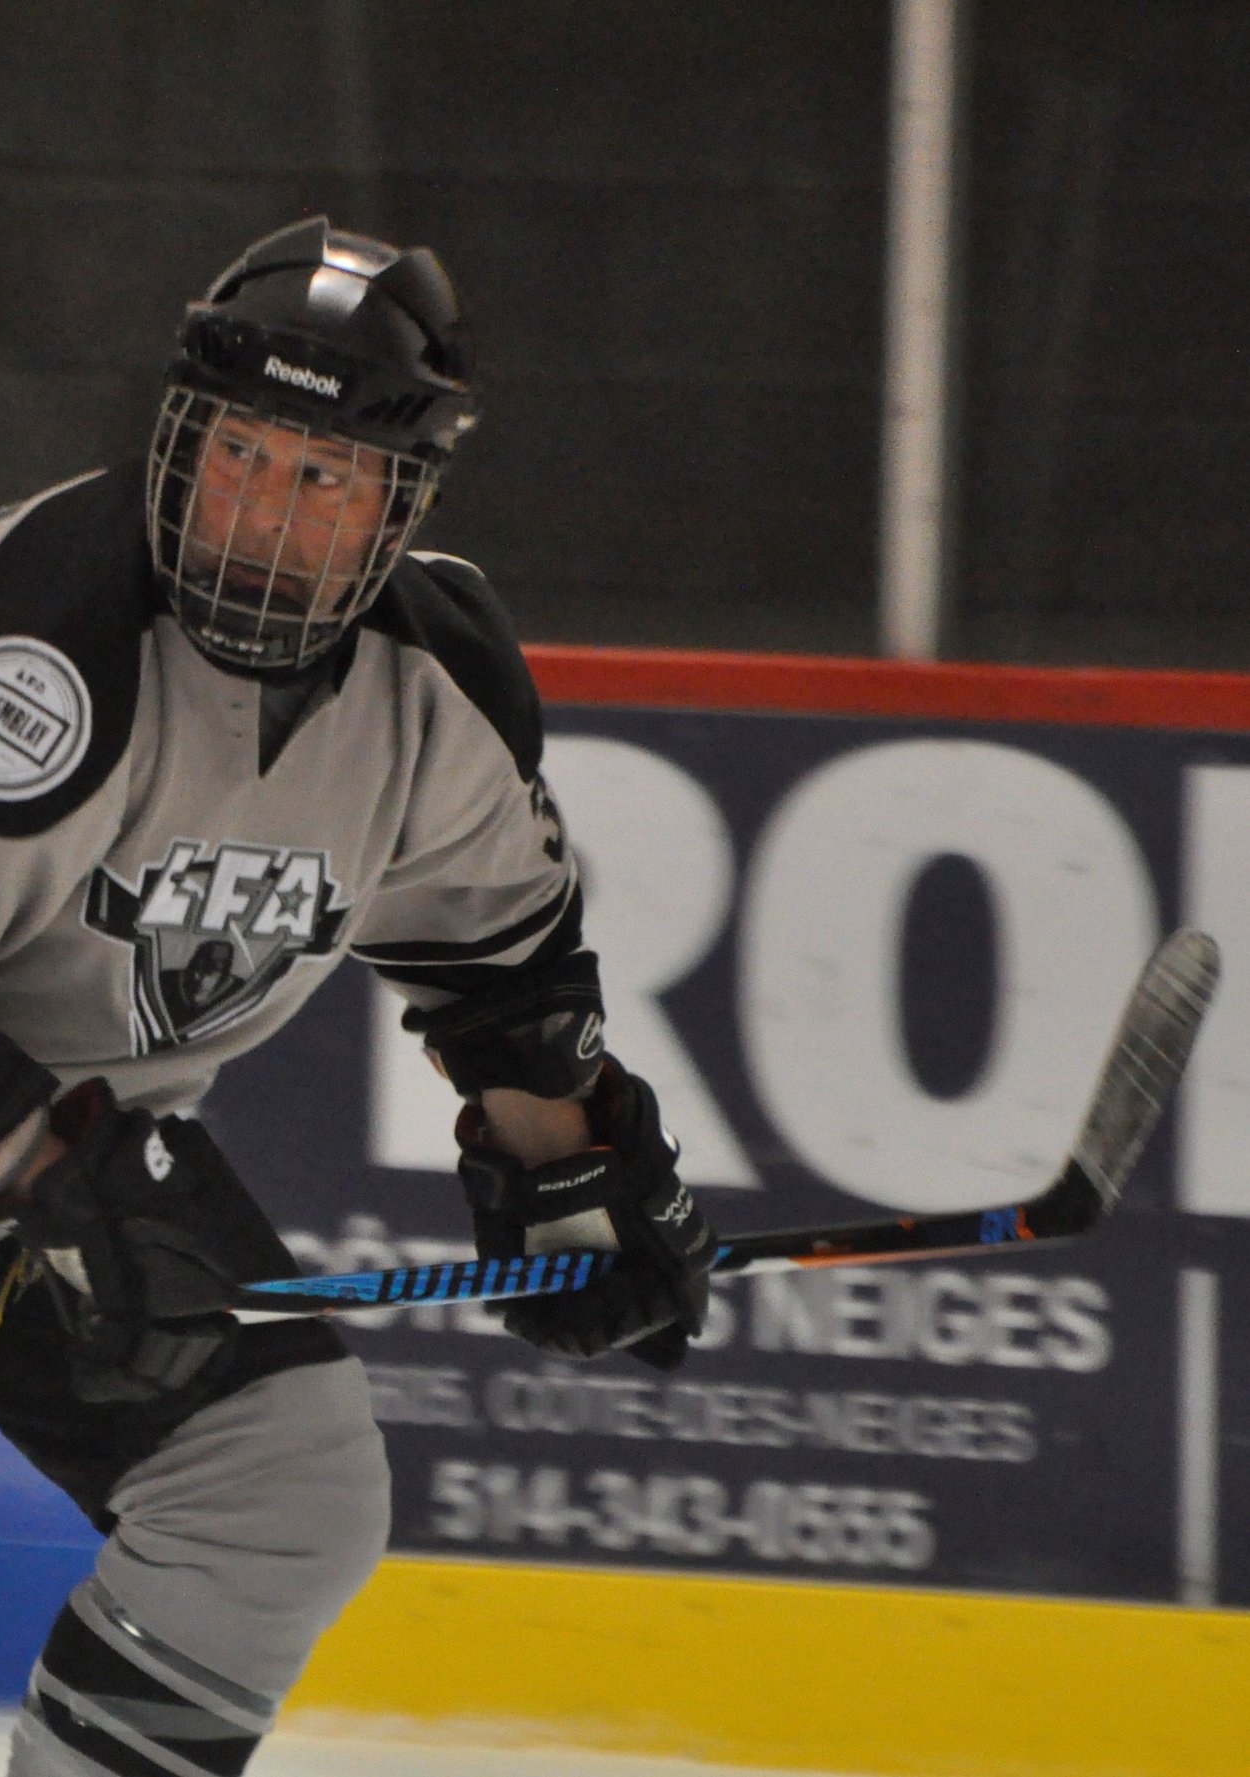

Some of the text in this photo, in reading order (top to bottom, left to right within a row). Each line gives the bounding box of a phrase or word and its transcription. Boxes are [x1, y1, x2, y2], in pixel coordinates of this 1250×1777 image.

[263, 353, 343, 399] Reebok
[138, 840, 328, 940] LFA
[366, 732, 1250, 1219] RO
[751, 1260, 1114, 1375] NEIGES
[483, 1359, 1040, 1465] CÔTE-DES-NEIGES
[430, 1458, 937, 1572] 514-343-0555
